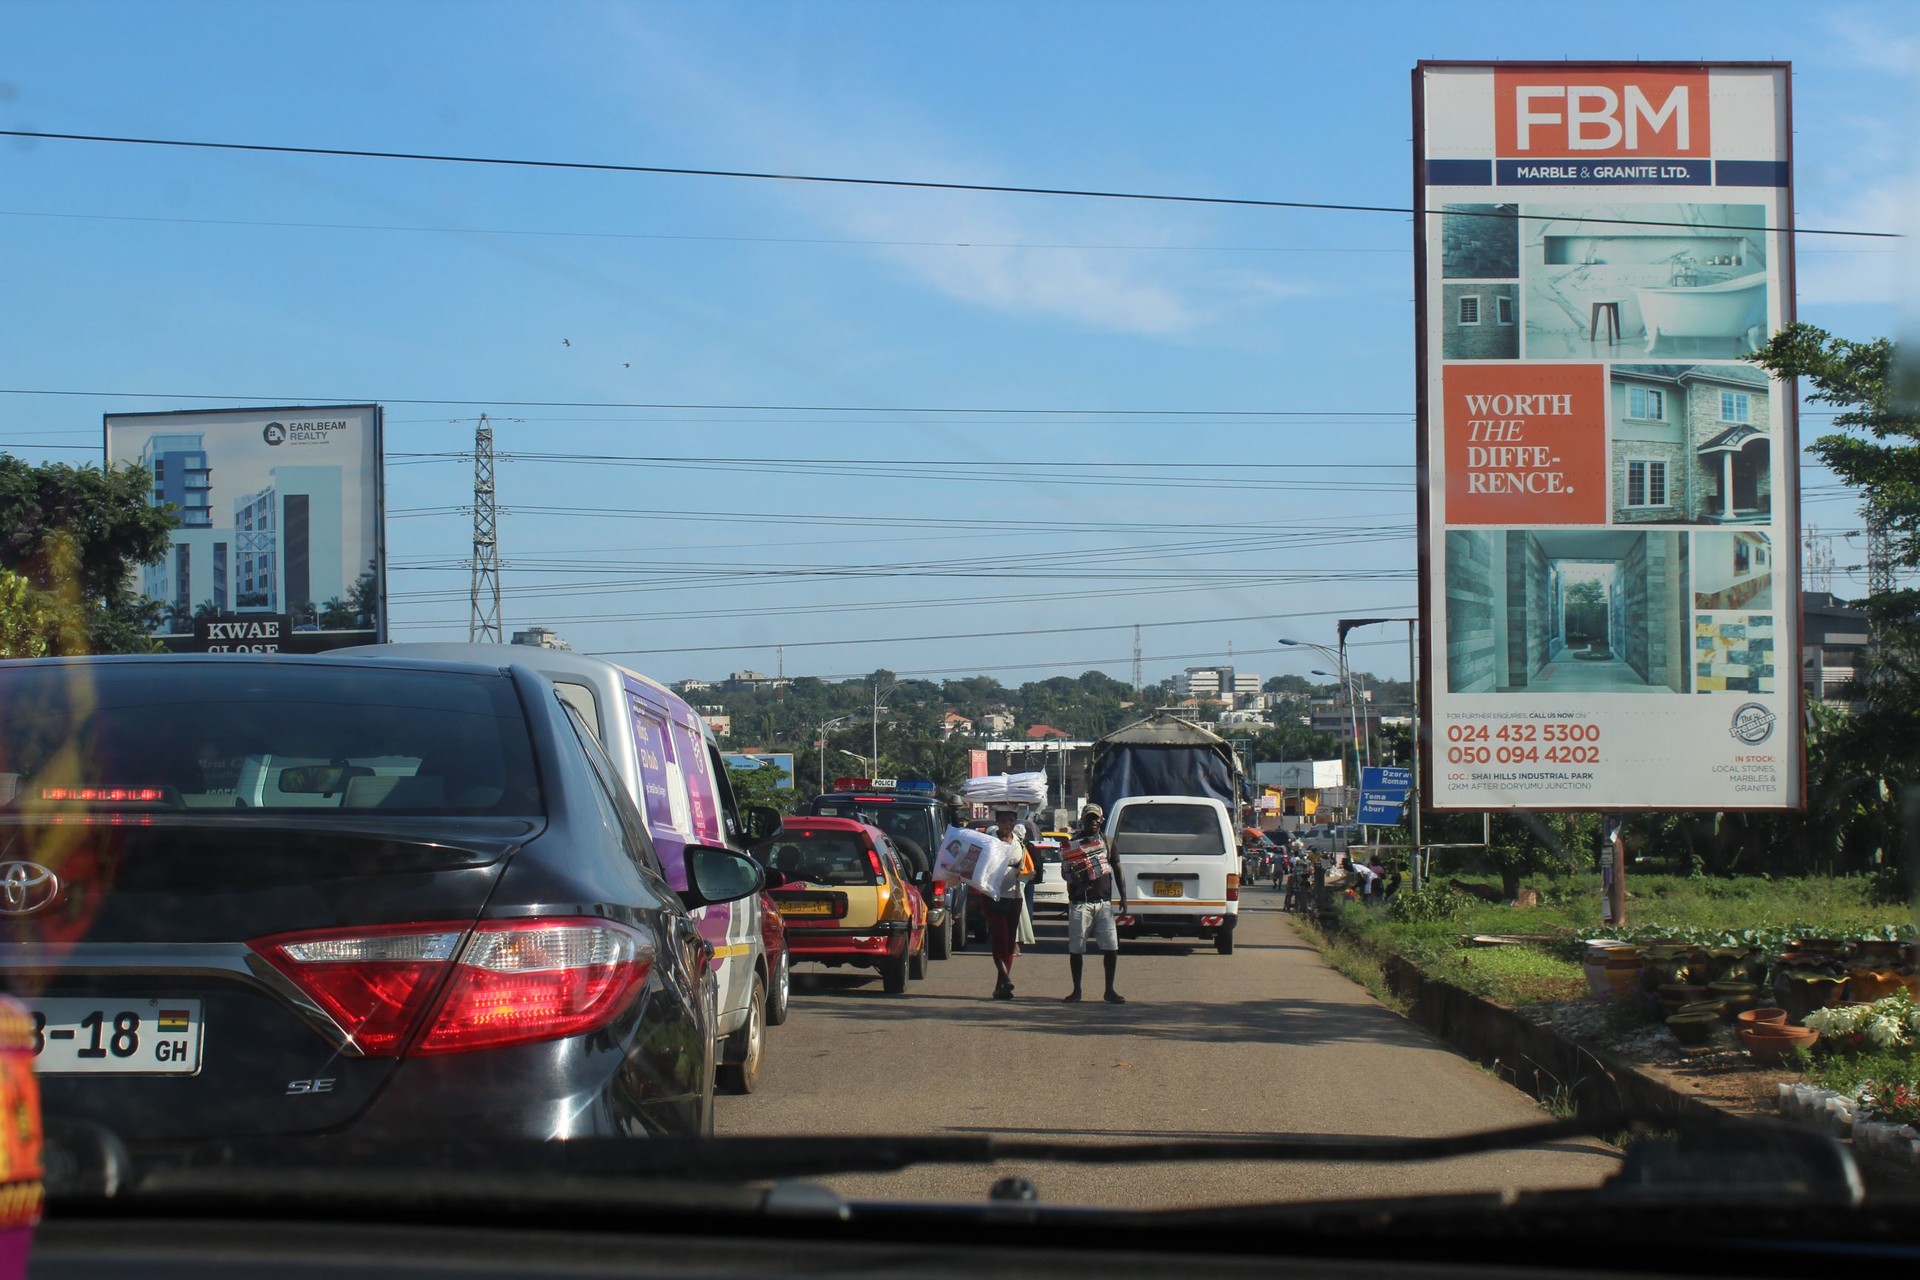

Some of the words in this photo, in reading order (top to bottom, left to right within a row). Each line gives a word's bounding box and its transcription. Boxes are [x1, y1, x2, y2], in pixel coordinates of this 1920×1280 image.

[1516, 85, 1690, 150] FBM
[1517, 166, 1577, 178] MARBLE
[1580, 167, 1591, 178] &
[1593, 166, 1658, 178] GRANITE
[1660, 166, 1690, 178] LTD.
[1464, 394, 1573, 416] WORTH
[289, 421, 347, 431] EARLBEAM
[1467, 419, 1525, 442] THE
[290, 431, 328, 440] REALTY
[1467, 446, 1561, 468] DIFFE-
[1467, 471, 1575, 494] RENCE.
[207, 621, 279, 640] KWAE
[1447, 724, 1490, 742] 024
[1496, 724, 1537, 742] 432
[1543, 724, 1600, 742] 5300
[1447, 746, 1491, 764] 050
[1496, 746, 1540, 764] 094
[1544, 746, 1600, 764] 4202
[1382, 770, 1412, 778] Dzorw
[1494, 772, 1517, 780] HILLS
[1448, 782, 1469, 790] (2KM
[1470, 782, 1499, 790] AFTER
[1500, 782, 1543, 790] DORYUMU
[1545, 782, 1592, 790] JUNCTION)
[1364, 792, 1386, 800] Tema
[155, 1040, 188, 1062] GH
[286, 1078, 337, 1095] SE
